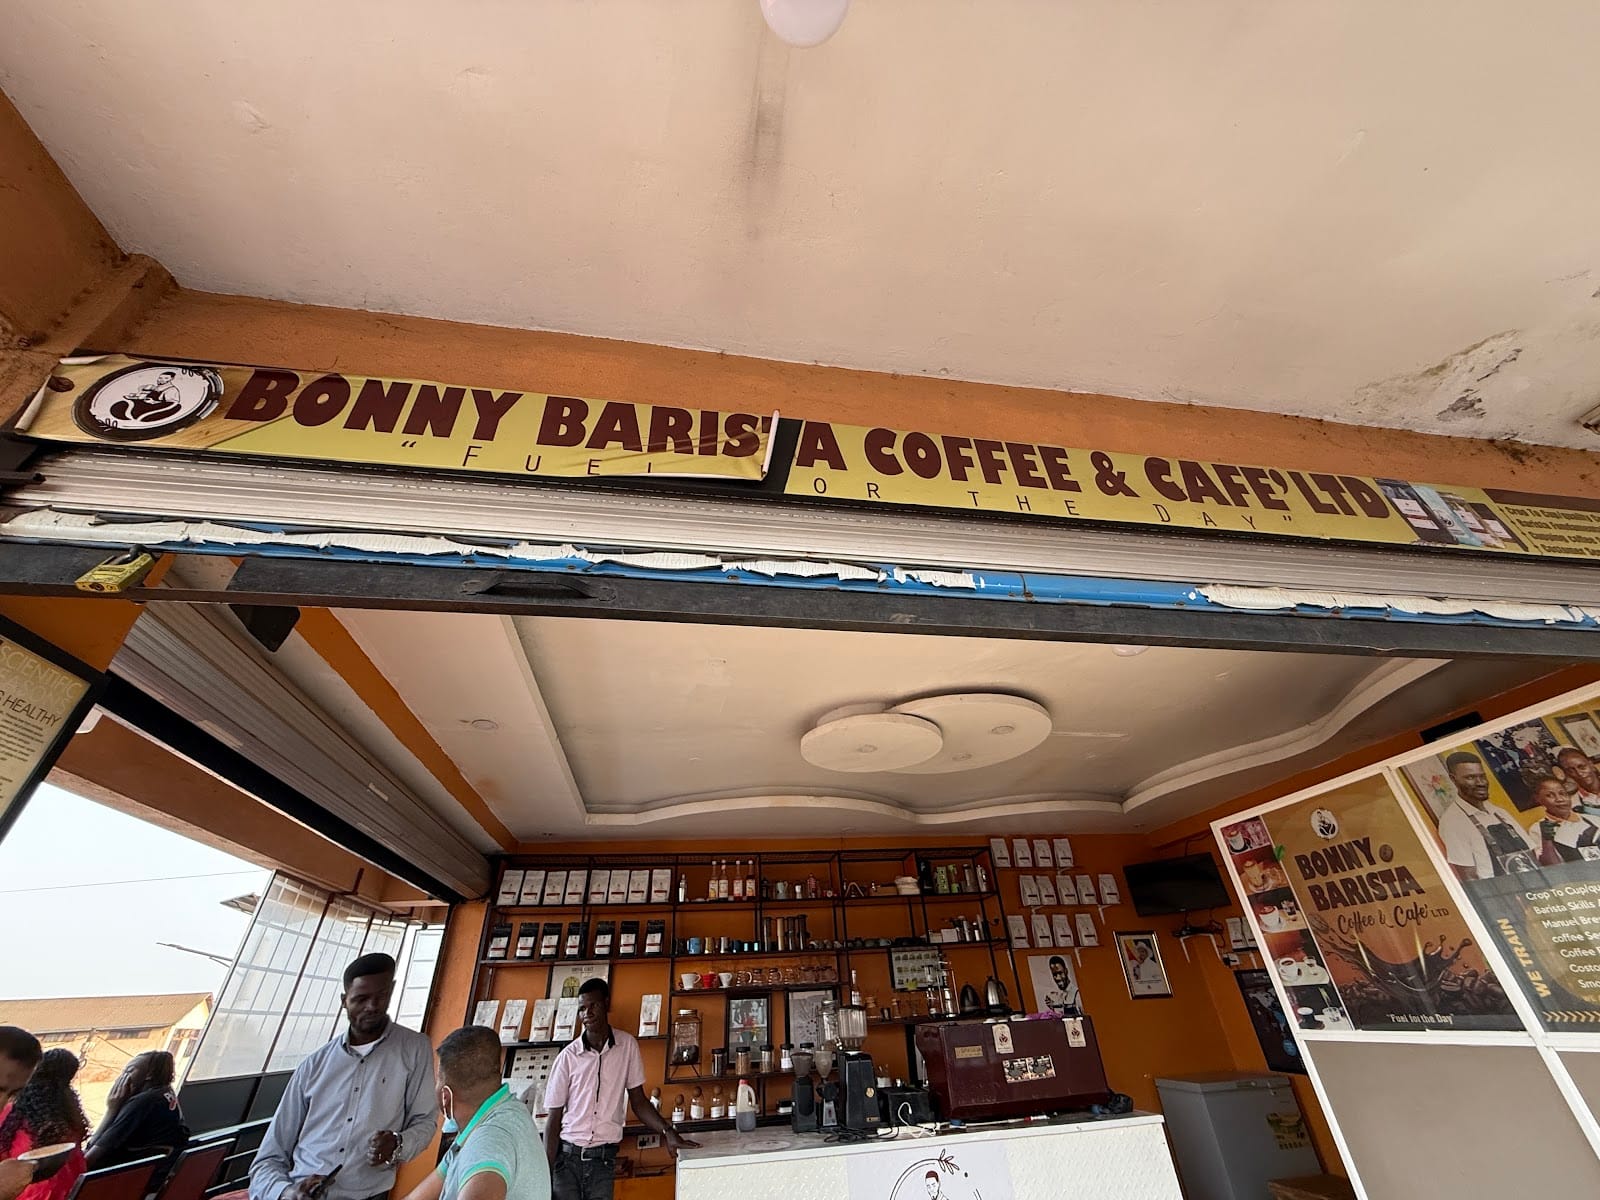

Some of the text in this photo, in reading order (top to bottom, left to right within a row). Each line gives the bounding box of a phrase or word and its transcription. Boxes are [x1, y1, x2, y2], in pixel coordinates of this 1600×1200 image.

[224, 368, 523, 442] BONNY
[864, 428, 1082, 493] COFFEE
[1090, 451, 1140, 497] &
[968, 491, 1080, 516] THE
[3, 694, 62, 727] HEALTHY
[1295, 837, 1377, 881] BONNY
[1308, 866, 1425, 912] BARISTA
[1526, 891, 1550, 901] Crop
[1551, 888, 1564, 897] To
[1533, 899, 1596, 915] Barista Skills
[1338, 910, 1376, 935] Coffee
[1431, 907, 1449, 918] LTD
[1542, 916, 1580, 929] Manuel
[1552, 932, 1584, 944] coffee
[1497, 918, 1551, 998] WE TRAIN
[1561, 946, 1596, 959] Coffee
[1420, 1013, 1436, 1024] the
